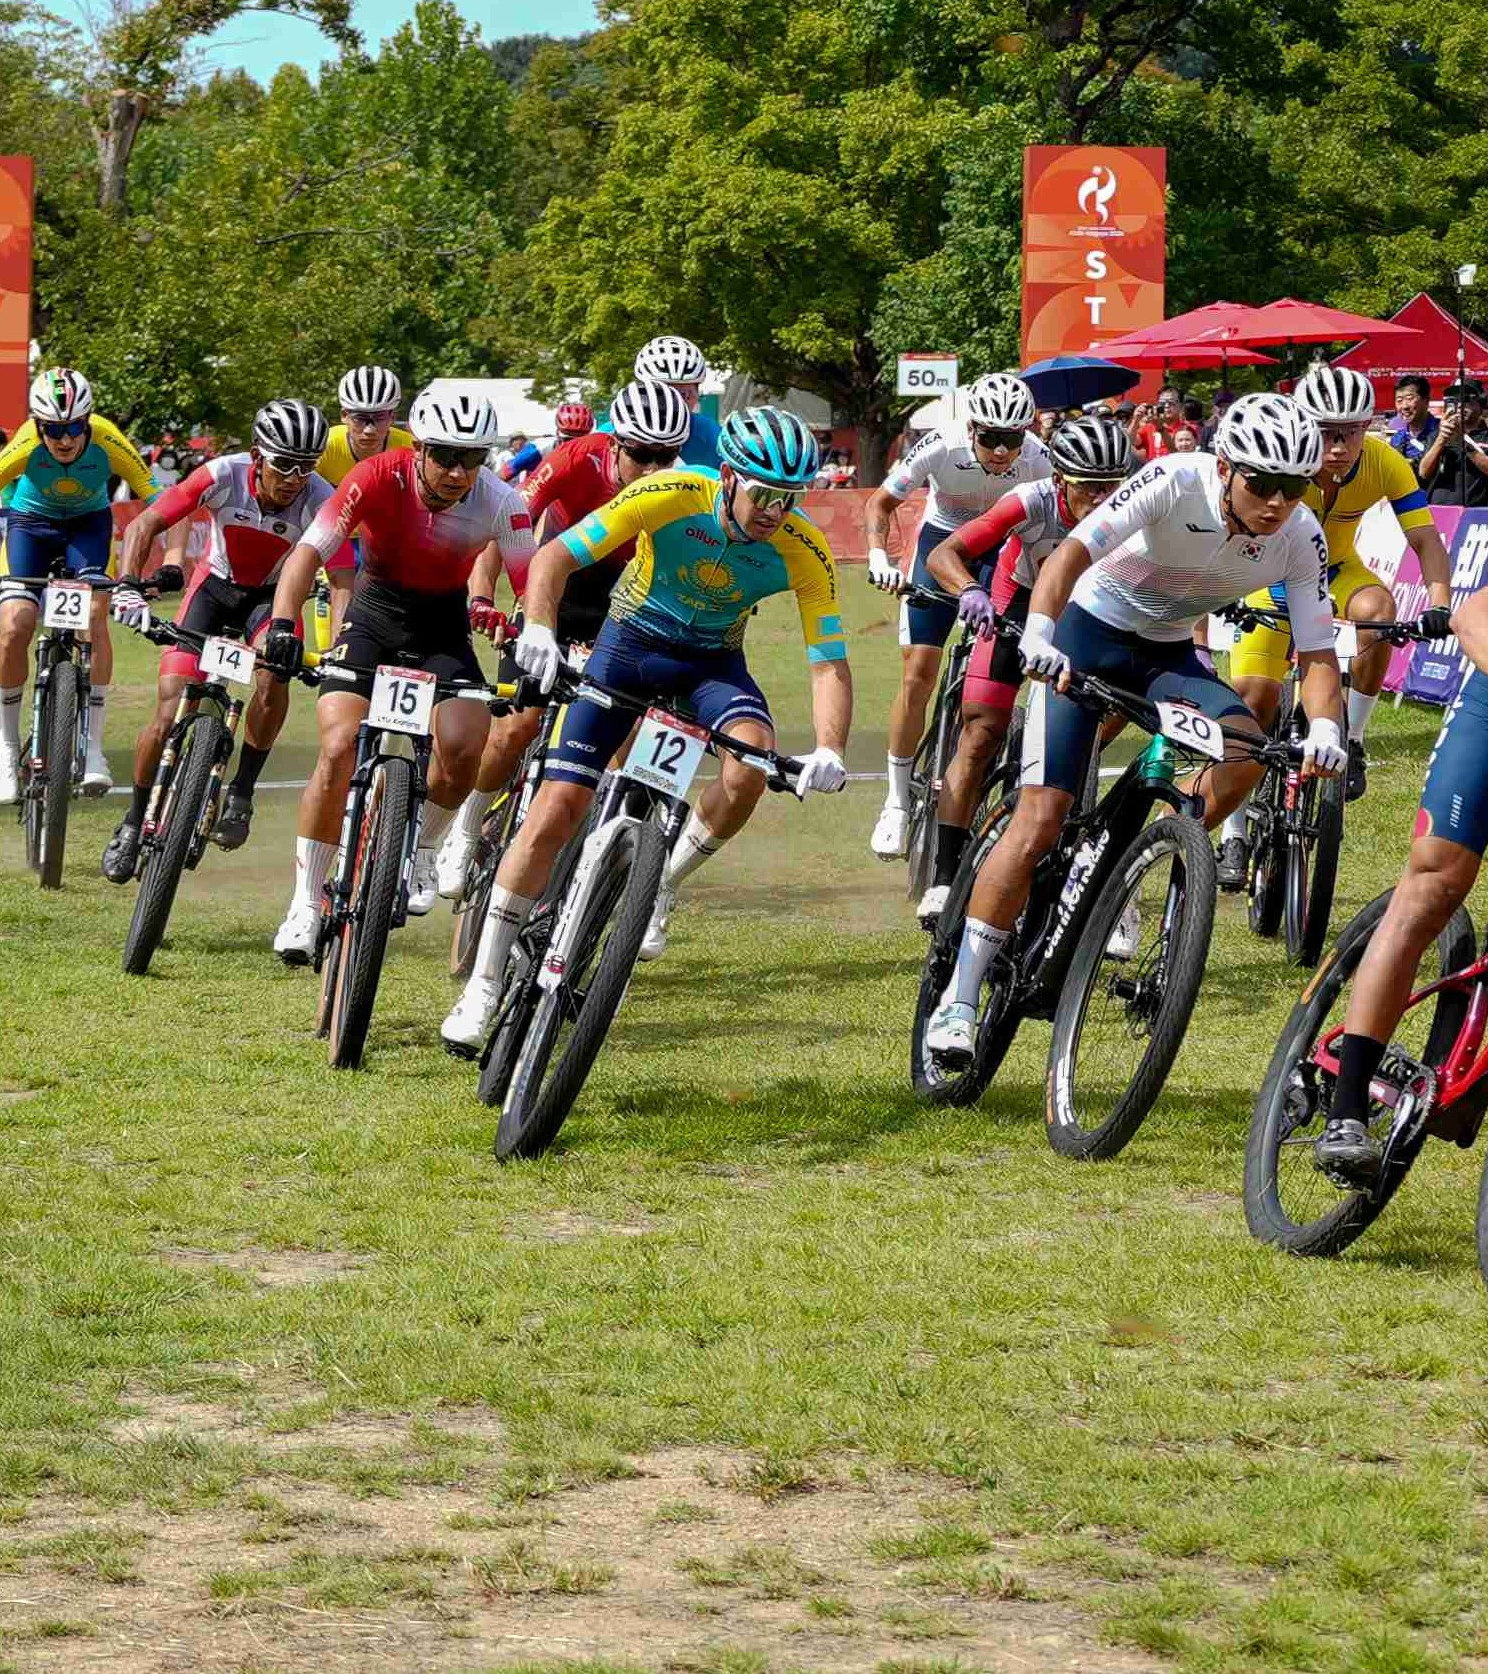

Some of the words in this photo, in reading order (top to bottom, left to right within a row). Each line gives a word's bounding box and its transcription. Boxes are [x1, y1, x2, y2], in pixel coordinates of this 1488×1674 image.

[907, 369, 949, 387] 50m
[1108, 466, 1167, 512] KOREA
[54, 591, 82, 617] 23
[217, 646, 241, 670] 14
[388, 679, 420, 716] 15
[1171, 709, 1211, 741] 20
[649, 729, 688, 775] 12
